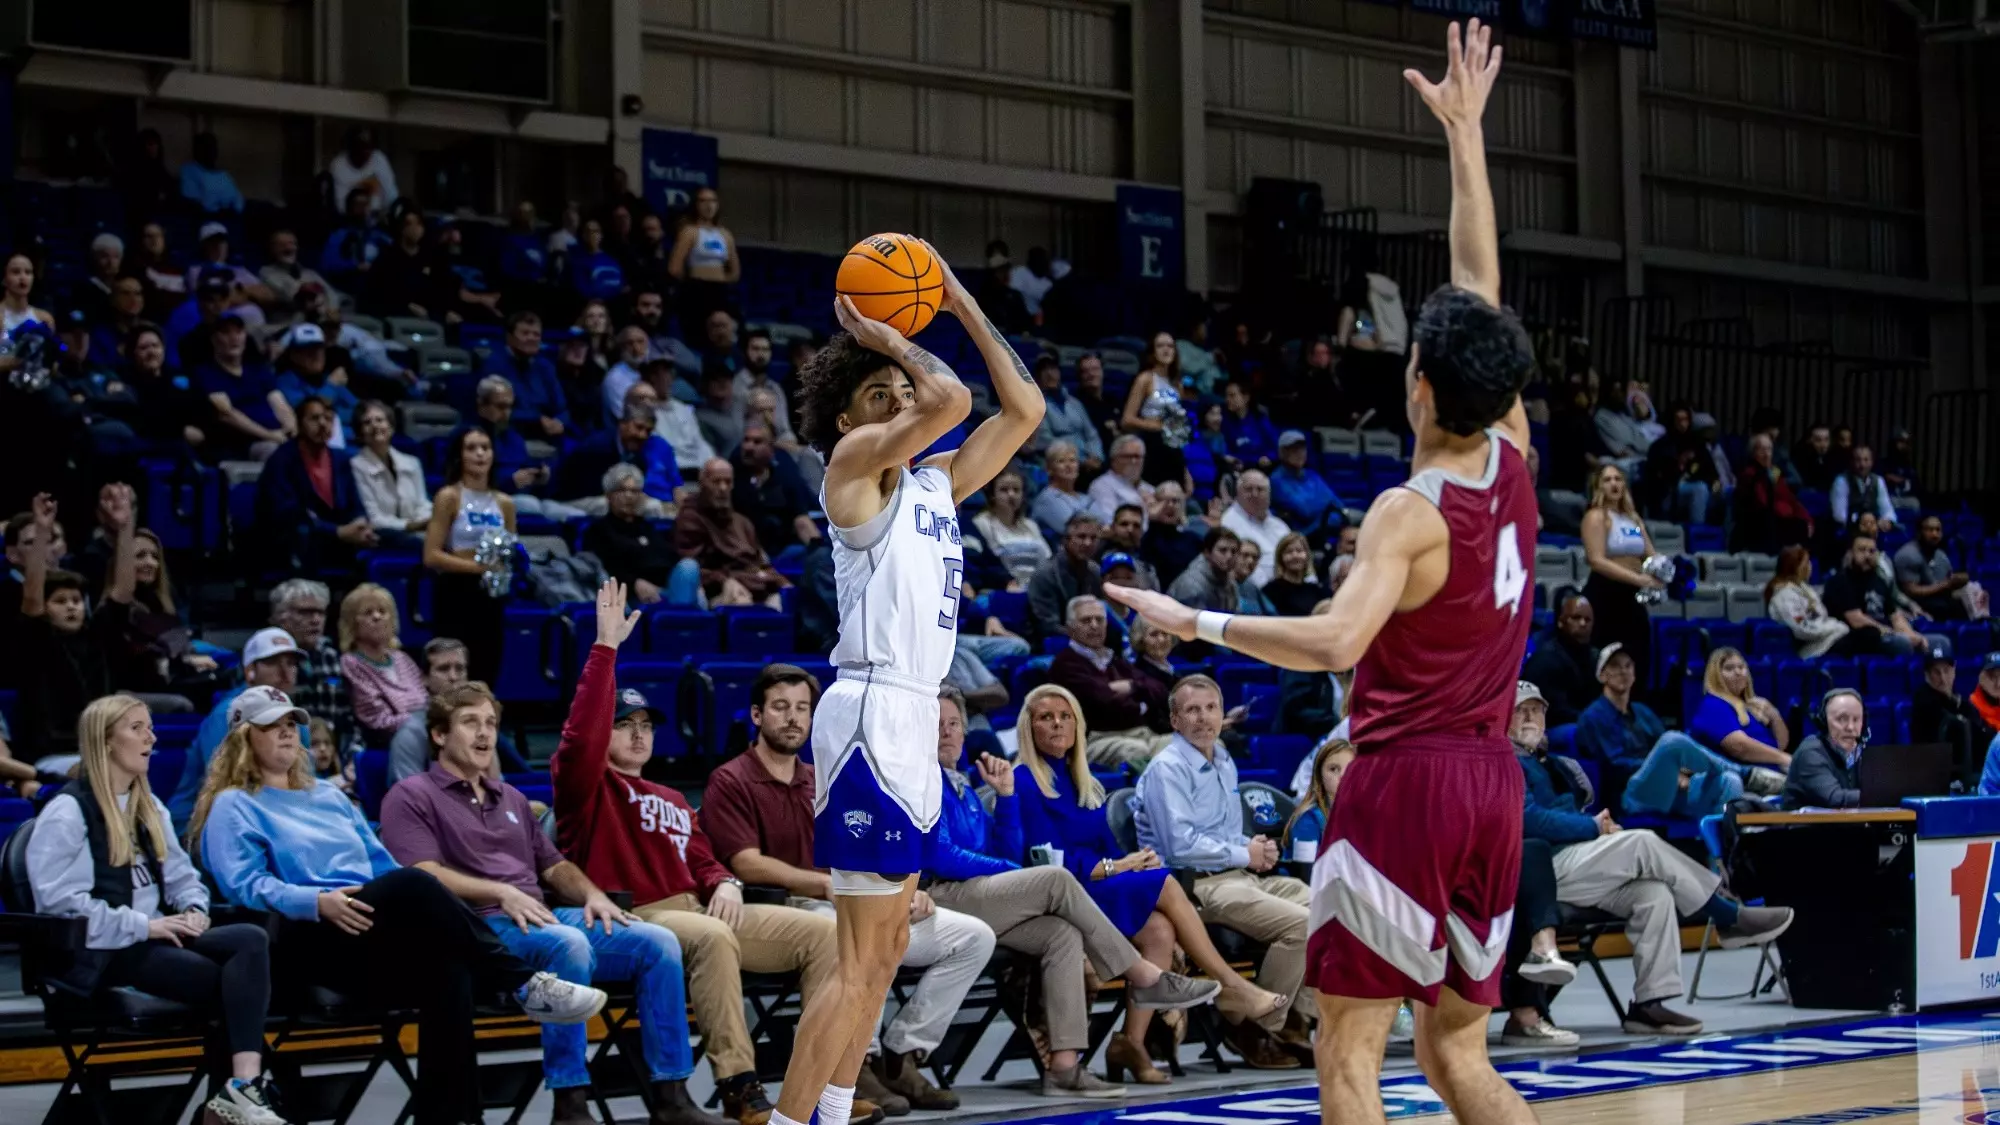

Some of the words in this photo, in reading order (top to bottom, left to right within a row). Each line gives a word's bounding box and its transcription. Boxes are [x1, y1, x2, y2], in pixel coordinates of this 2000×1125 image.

[1139, 234, 1164, 279] E
[938, 557, 963, 630] 5
[1494, 521, 1528, 619] 4
[843, 810, 873, 826] CNU
